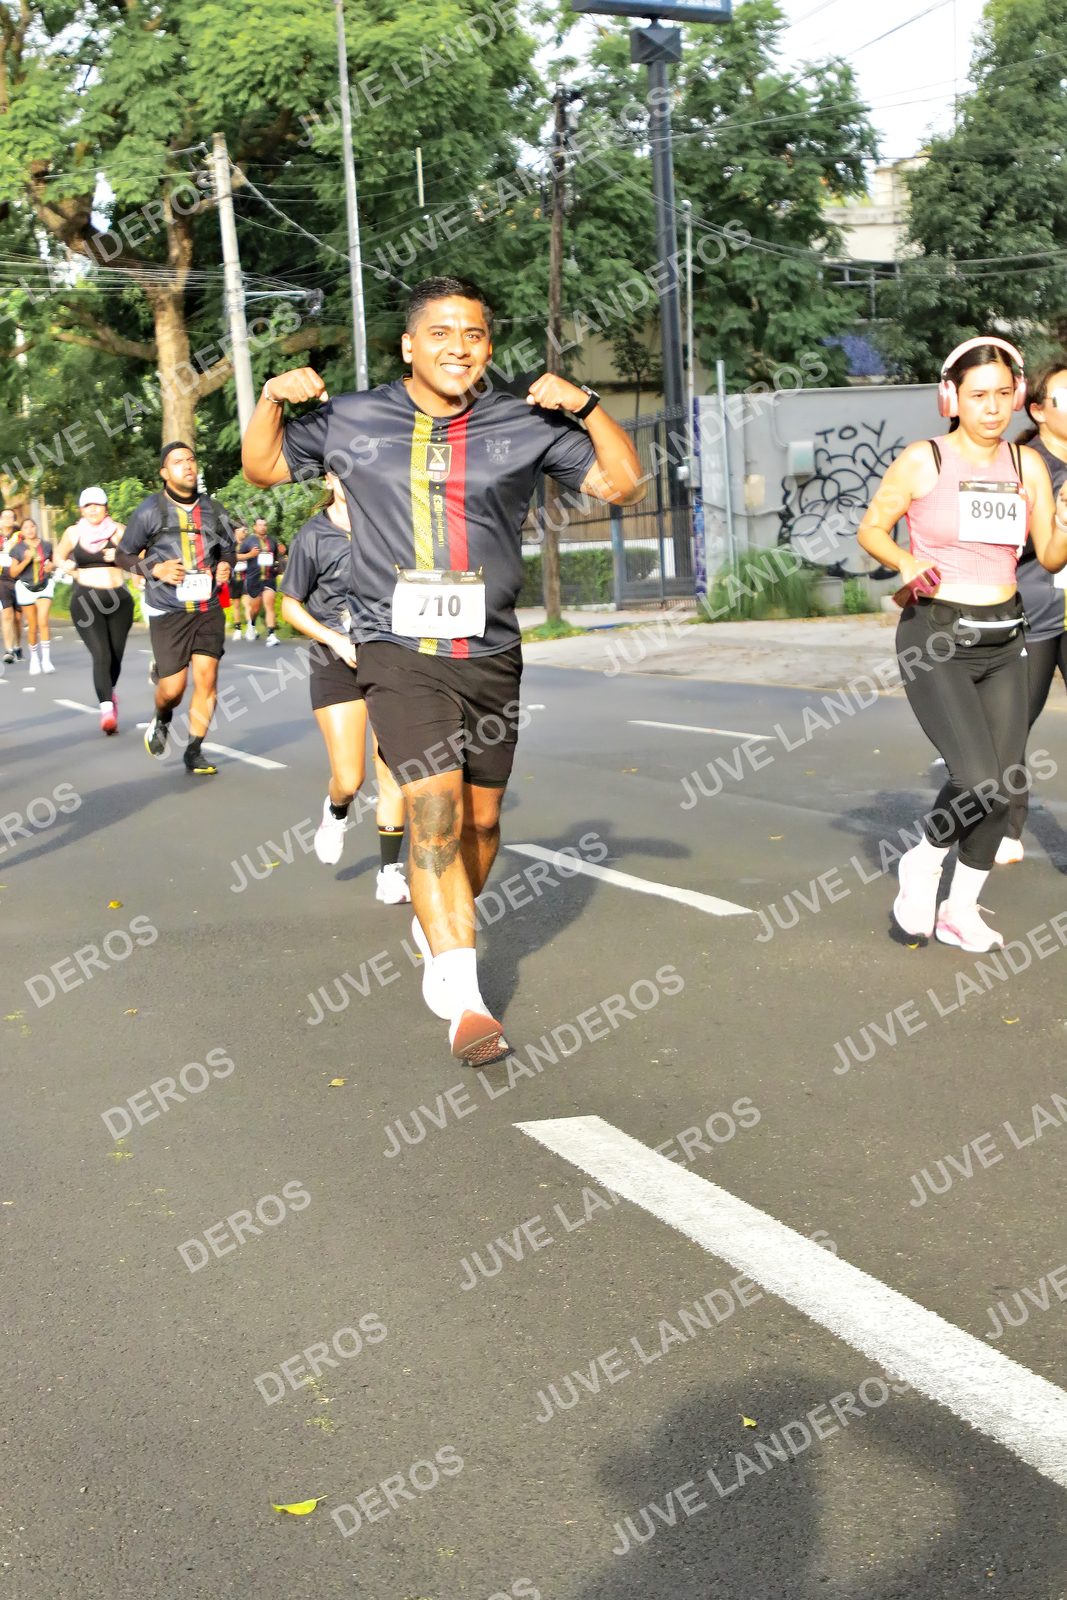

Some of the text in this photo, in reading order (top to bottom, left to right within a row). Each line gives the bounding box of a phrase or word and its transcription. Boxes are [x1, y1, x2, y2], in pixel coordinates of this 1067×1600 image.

[815, 420, 886, 447] TOY
[971, 500, 1017, 521] 8904
[417, 594, 461, 617] 710
